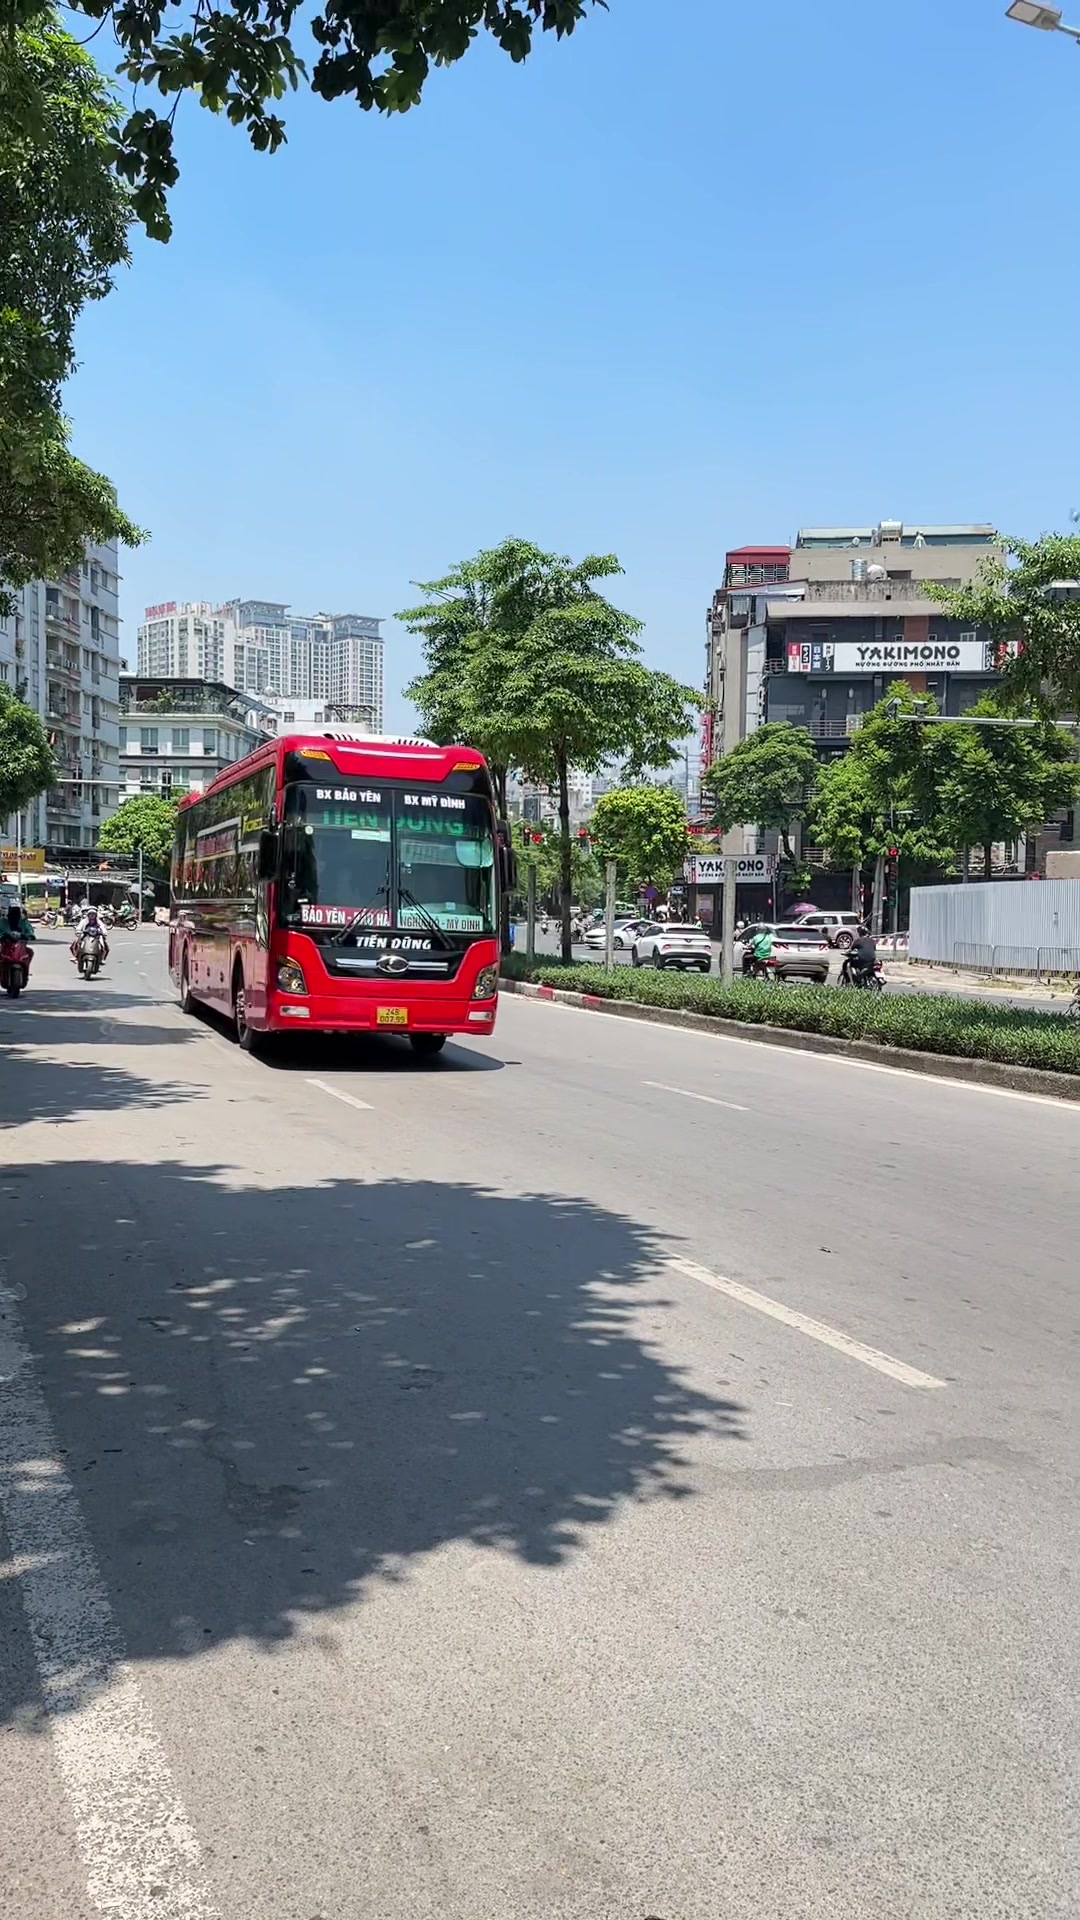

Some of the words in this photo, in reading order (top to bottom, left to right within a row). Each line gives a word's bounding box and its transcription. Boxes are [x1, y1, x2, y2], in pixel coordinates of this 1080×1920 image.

[856, 645, 960, 660] YAKIMONO
[316, 789, 332, 800] BX
[334, 788, 357, 801] BẢO
[360, 790, 381, 803] YÊN
[404, 795, 419, 806] BX
[421, 795, 438, 807] MỸ
[440, 796, 466, 809] ĐÌNH
[698, 860, 764, 872] YAKONO
[302, 904, 322, 922] BẢO
[325, 907, 345, 924] YÊN
[376, 910, 391, 926] HÀ
[356, 934, 388, 948] TIẾN
[391, 936, 432, 950] DŨNG
